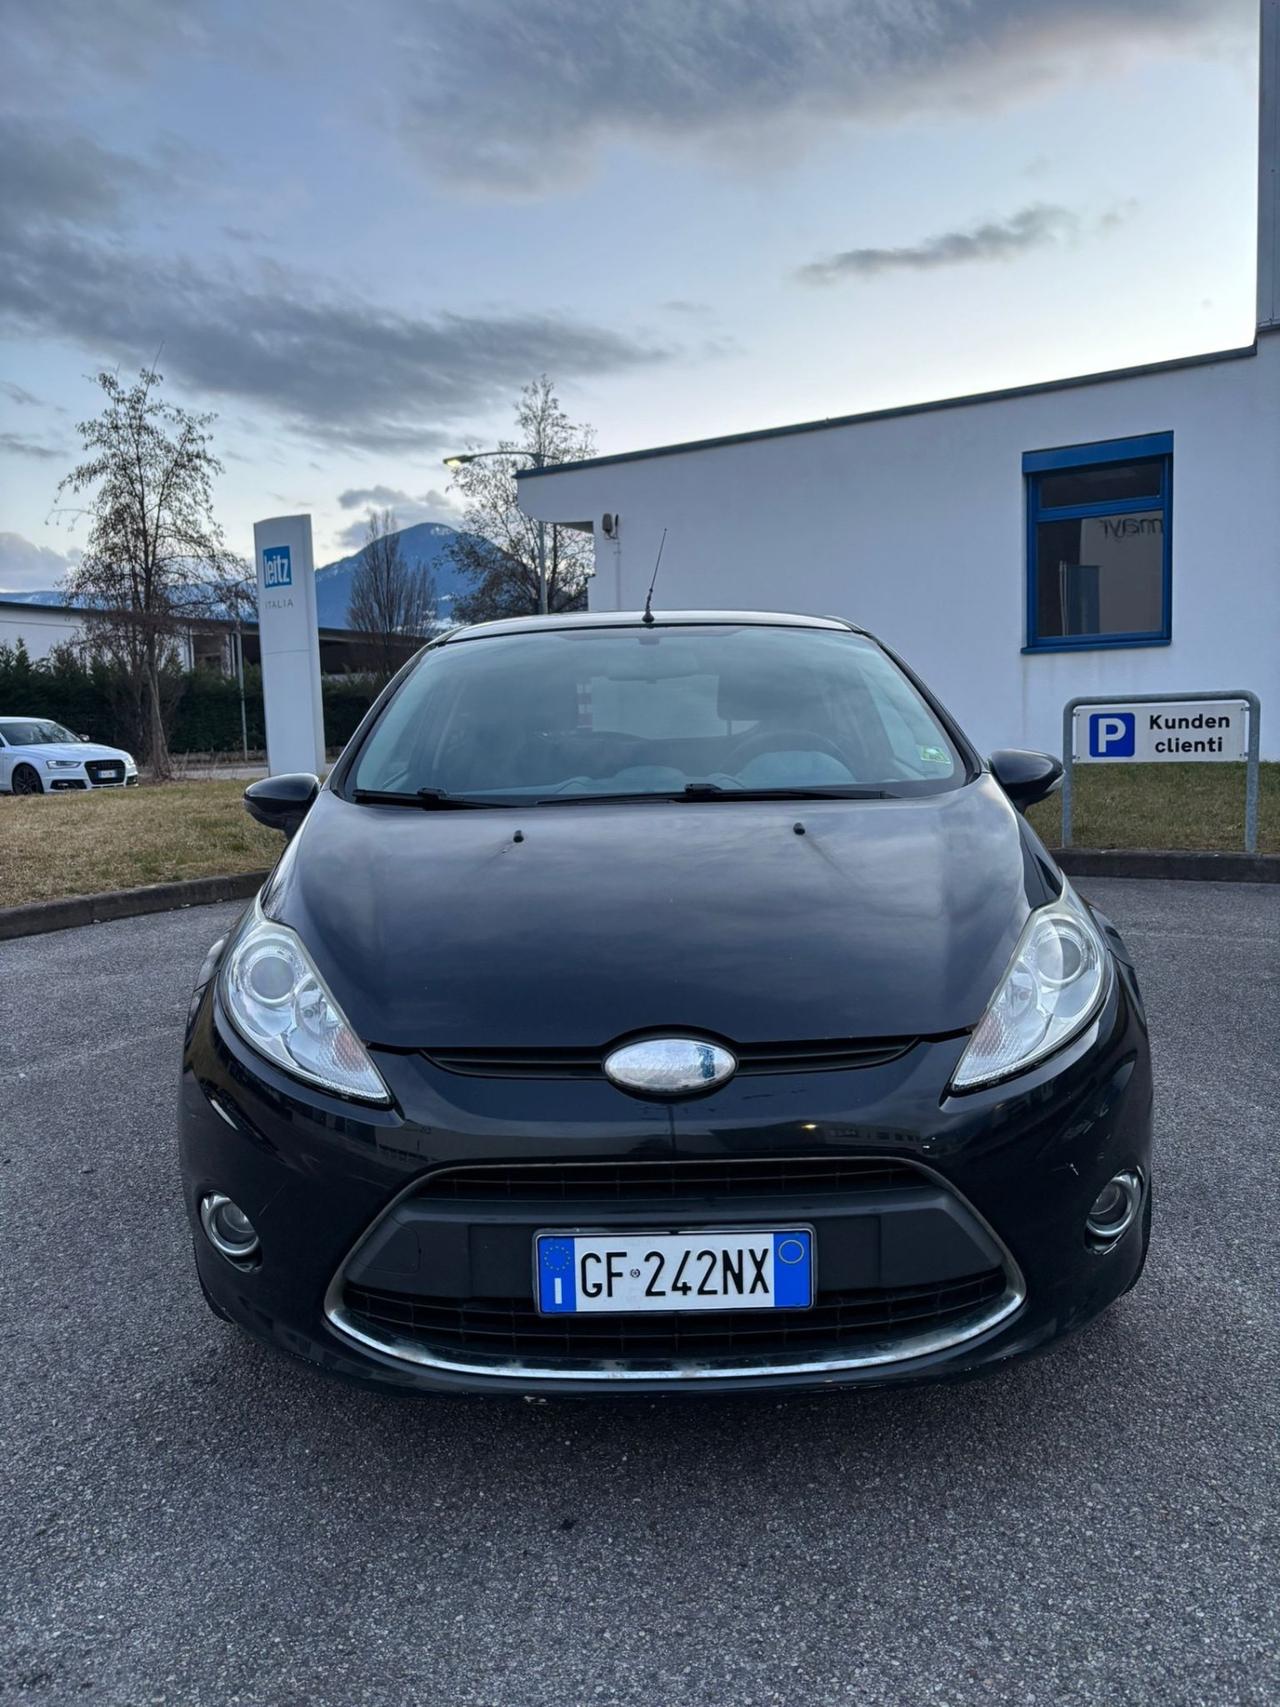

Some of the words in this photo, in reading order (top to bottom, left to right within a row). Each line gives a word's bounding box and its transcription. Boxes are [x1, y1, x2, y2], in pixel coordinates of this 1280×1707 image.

[264, 555, 290, 585] leitz
[265, 598, 294, 609] ITALIA
[1149, 714, 1230, 730] Kunden
[1098, 717, 1126, 753] P
[1155, 737, 1223, 753] clienti
